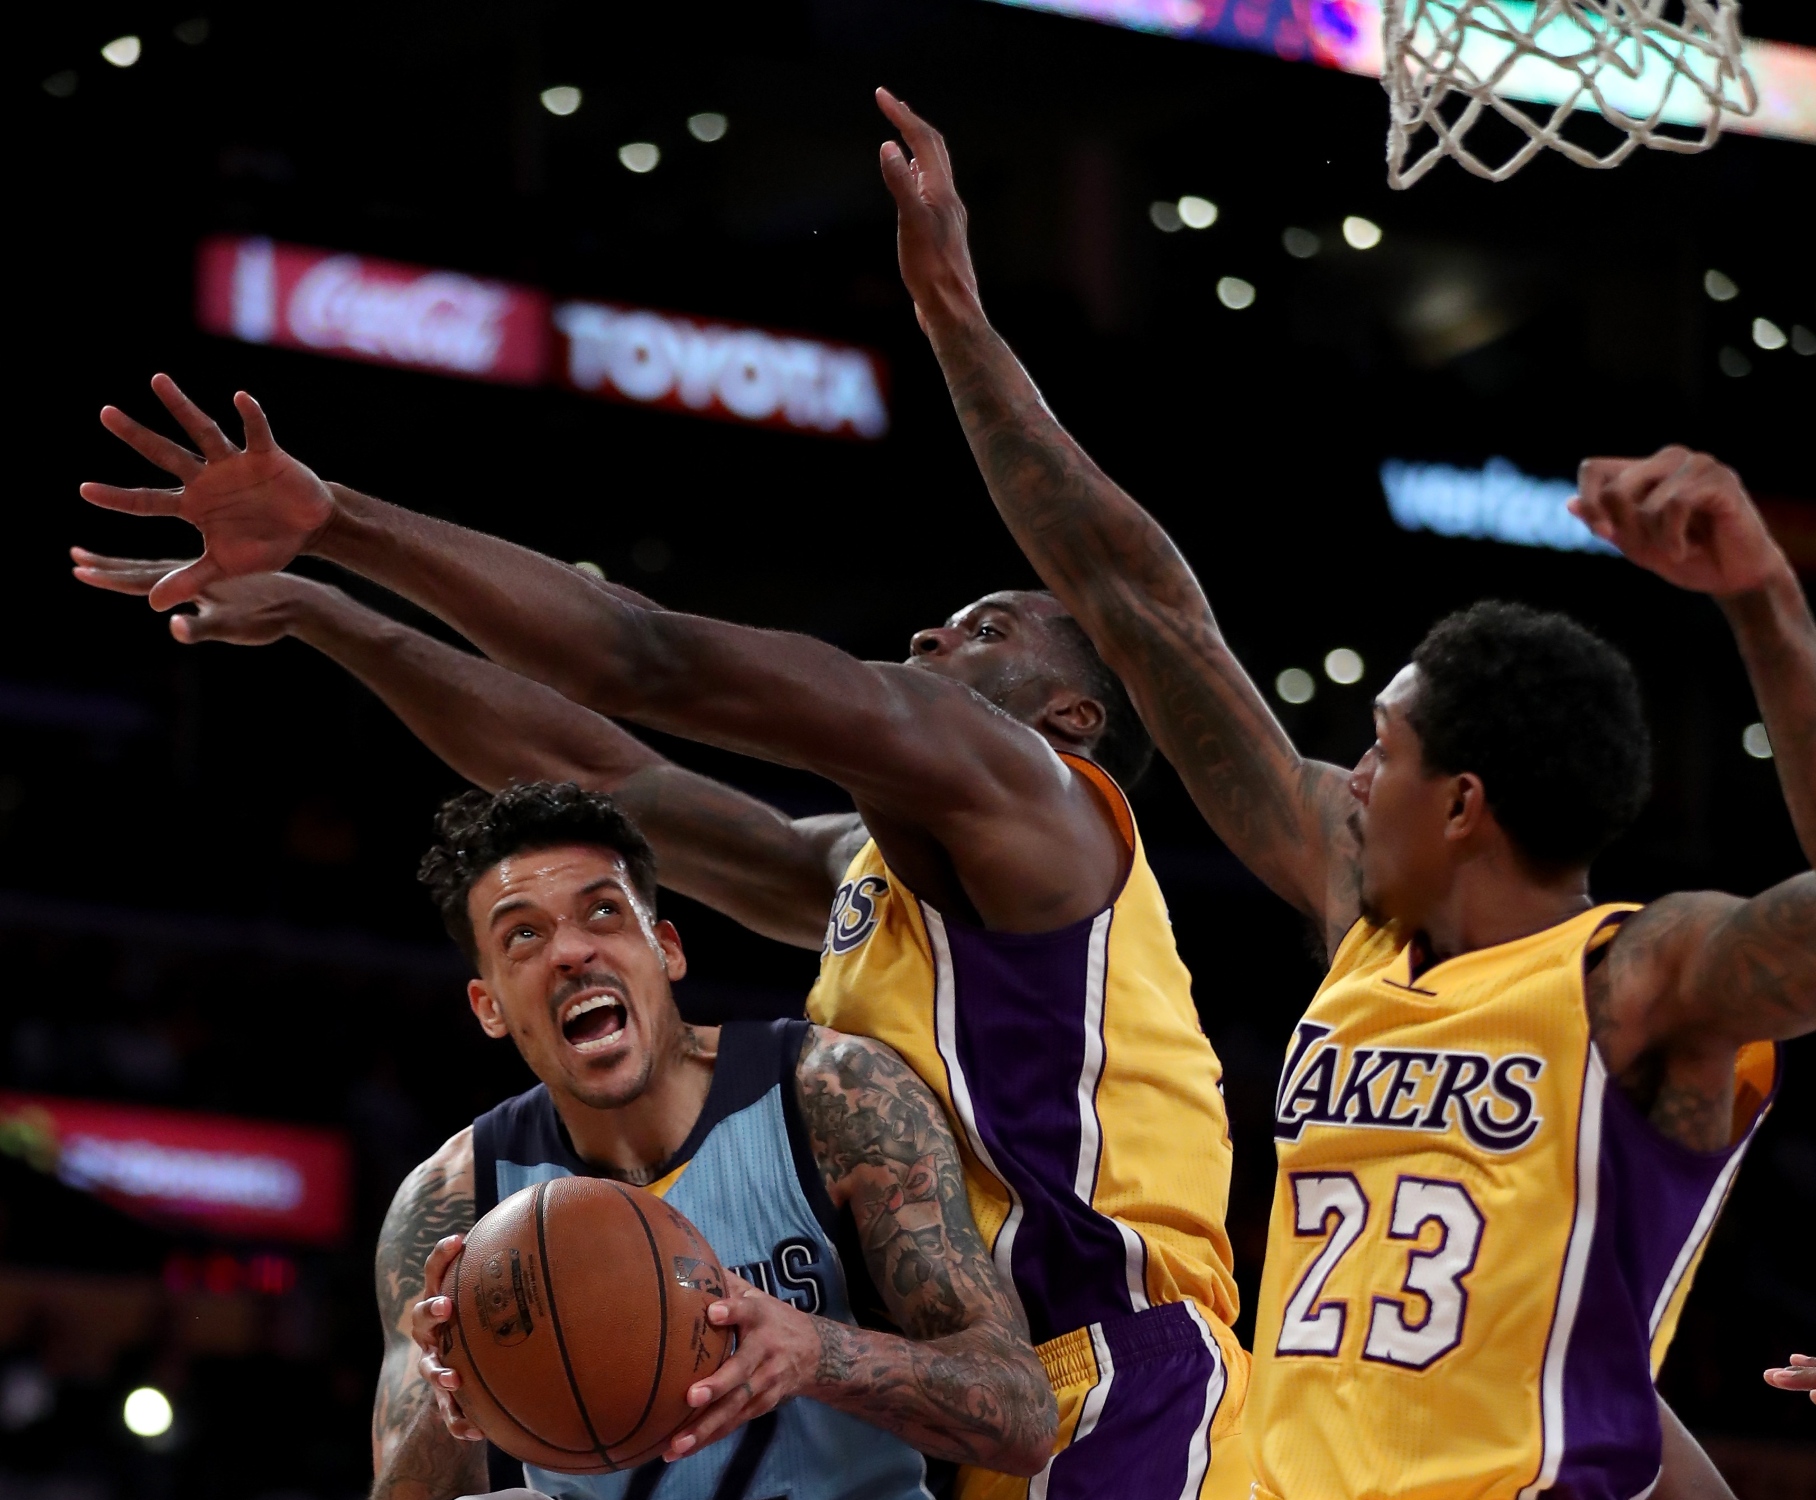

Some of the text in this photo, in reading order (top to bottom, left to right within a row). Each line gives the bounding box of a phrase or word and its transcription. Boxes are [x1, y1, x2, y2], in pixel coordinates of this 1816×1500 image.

[553, 303, 889, 438] TOYOTA
[1274, 1020, 1546, 1154] LAKERS
[1275, 1171, 1486, 1372] 23
